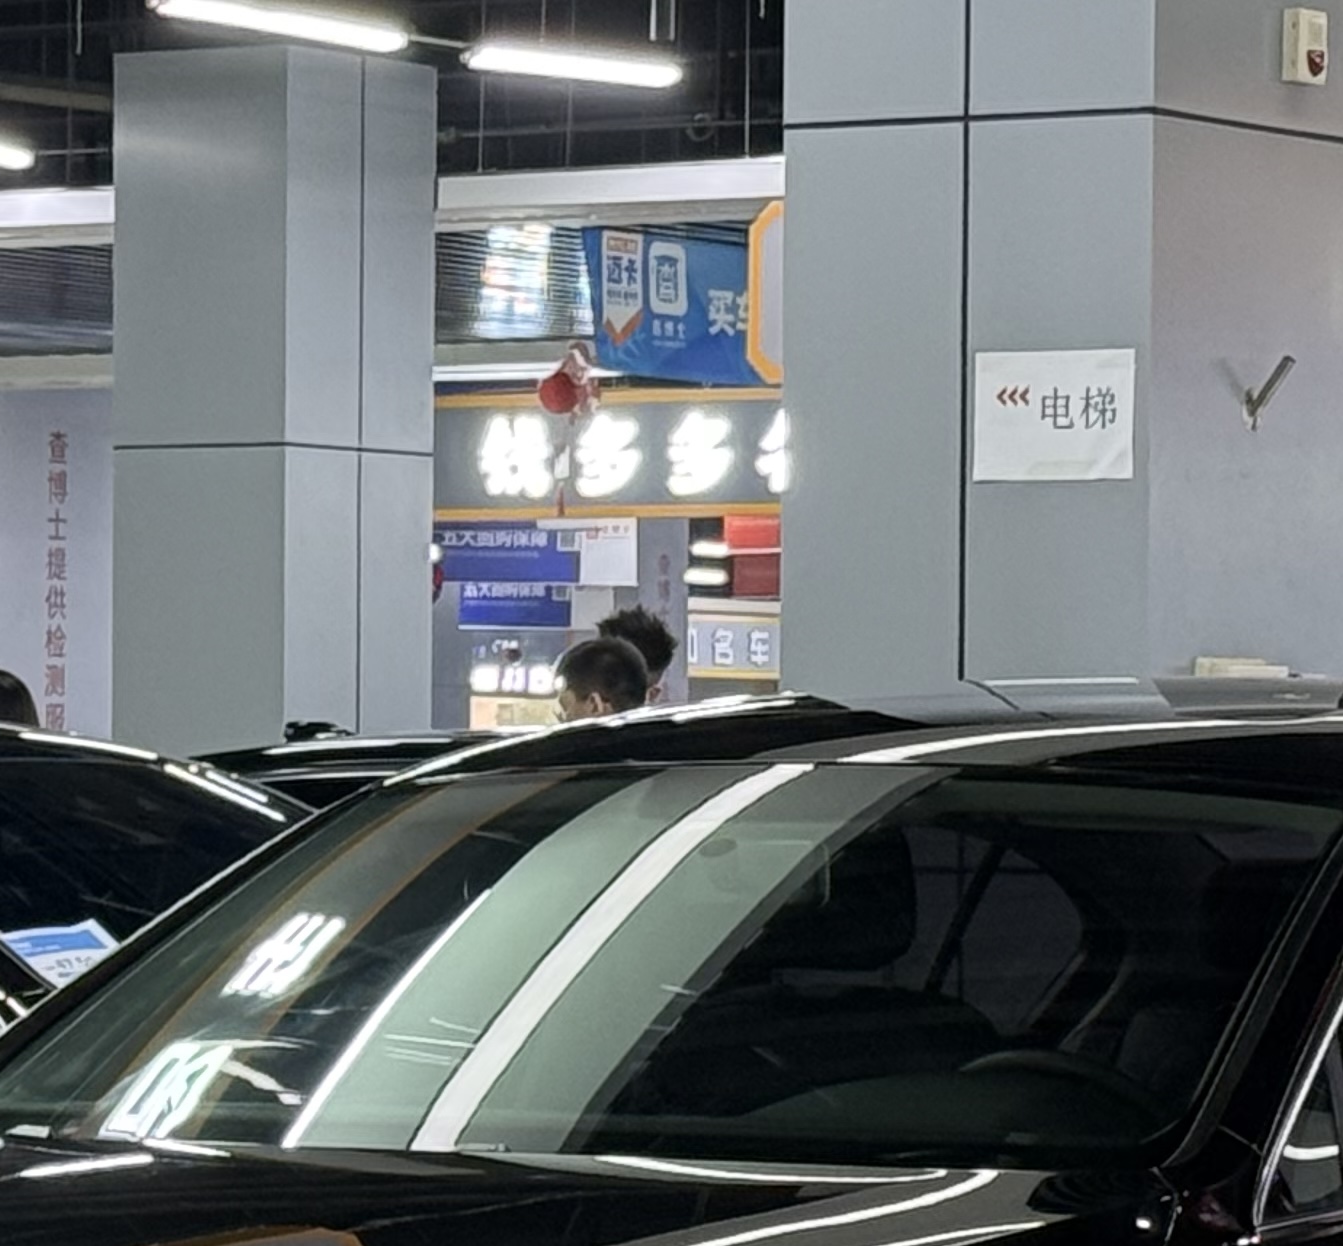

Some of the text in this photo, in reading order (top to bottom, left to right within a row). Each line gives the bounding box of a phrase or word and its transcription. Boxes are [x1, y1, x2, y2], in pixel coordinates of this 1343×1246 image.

[1040, 386, 1118, 430] 电梯
[478, 408, 789, 497] 钱多多
